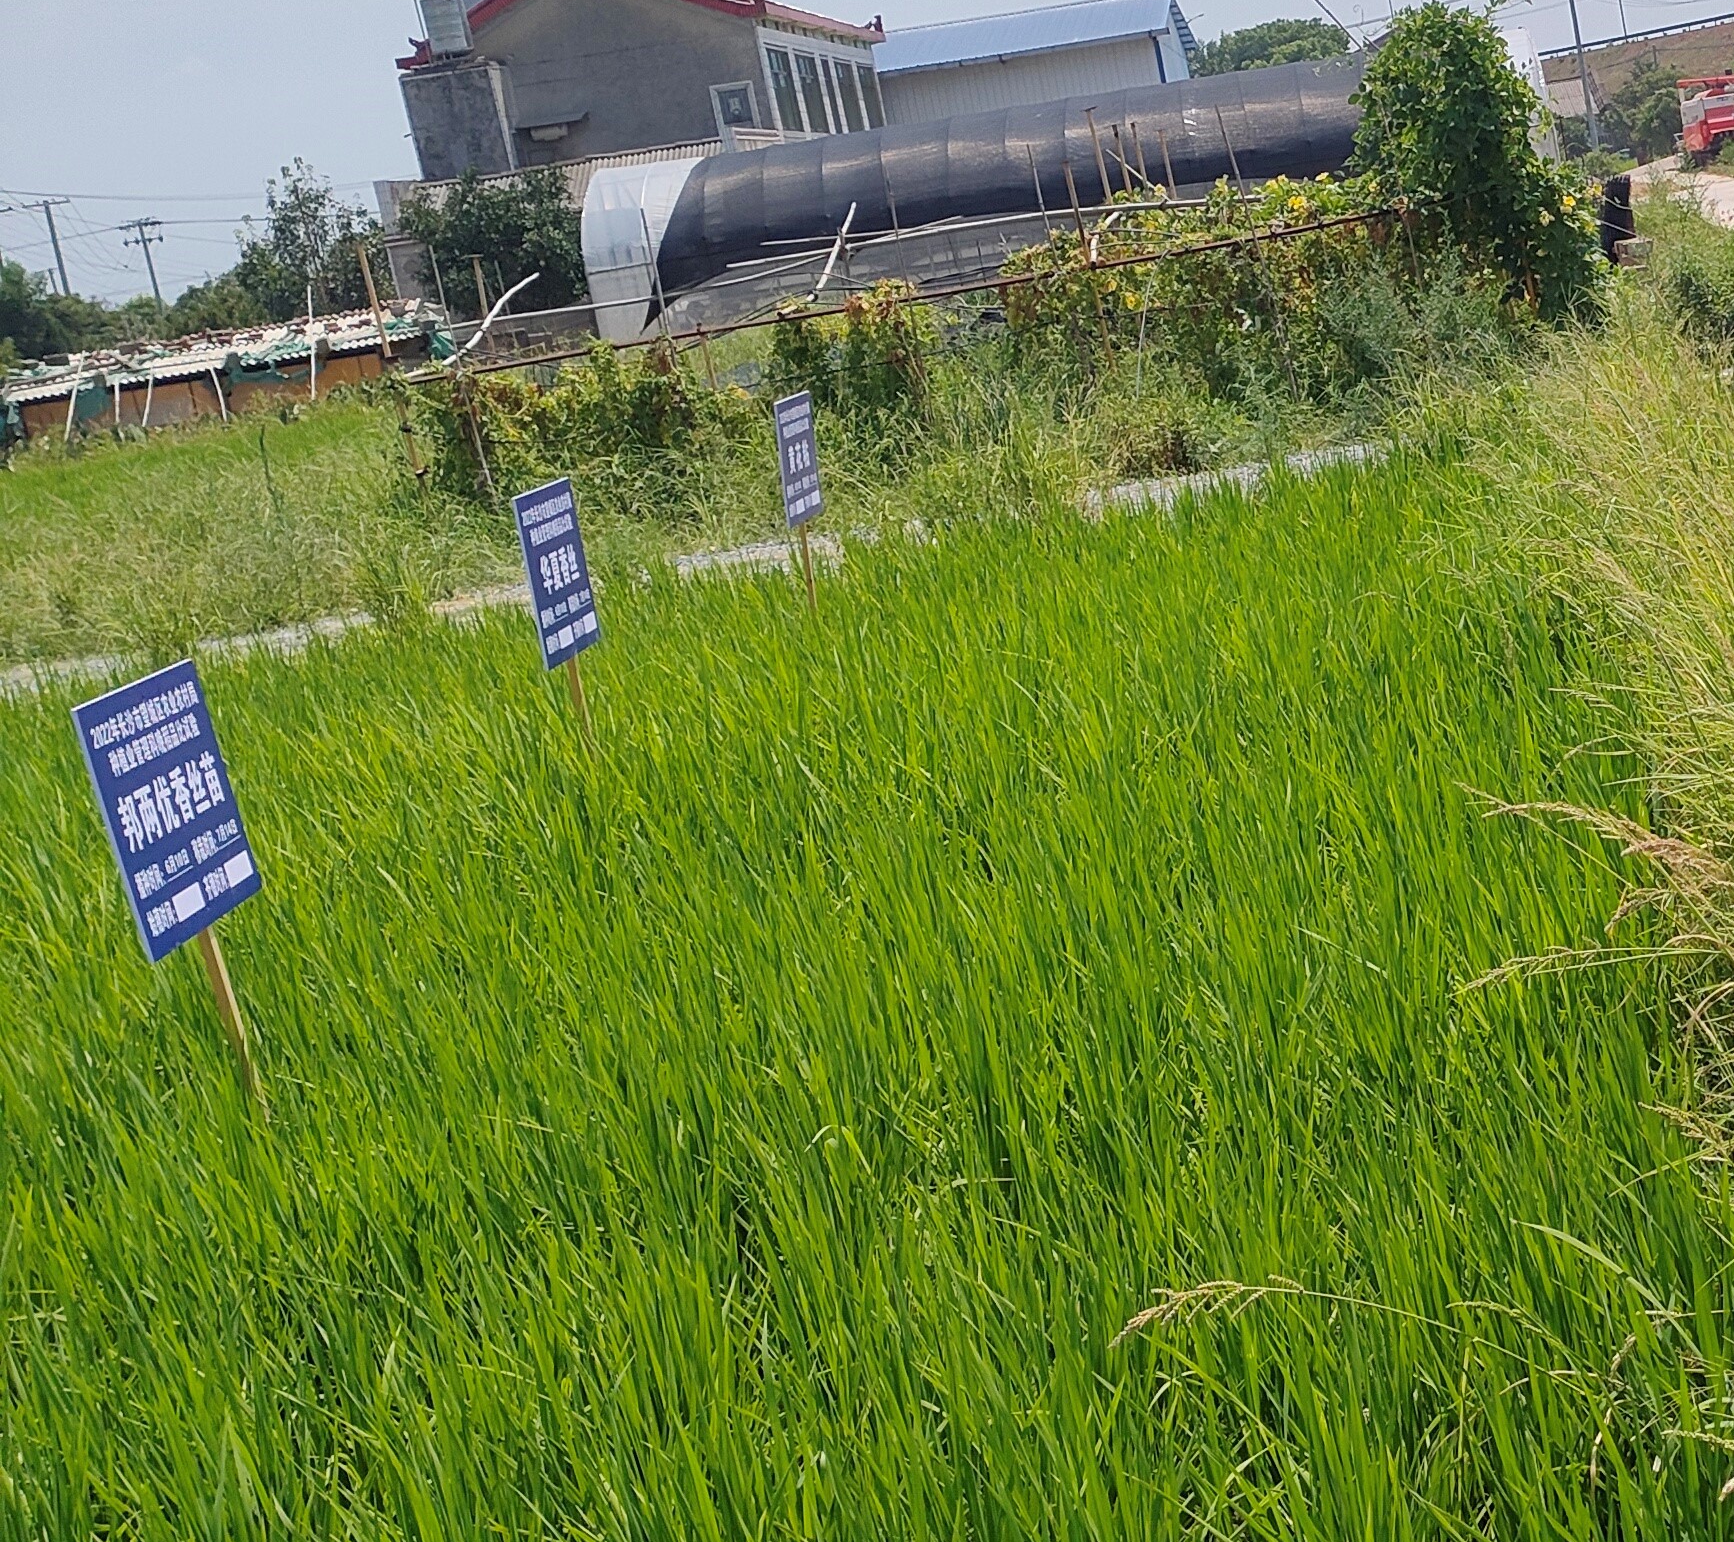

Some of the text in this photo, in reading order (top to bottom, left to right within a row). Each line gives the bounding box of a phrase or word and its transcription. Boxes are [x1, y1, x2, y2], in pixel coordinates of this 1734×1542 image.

[539, 543, 580, 595] 华夏香丝
[116, 750, 225, 854] 邦两优香丝苗
